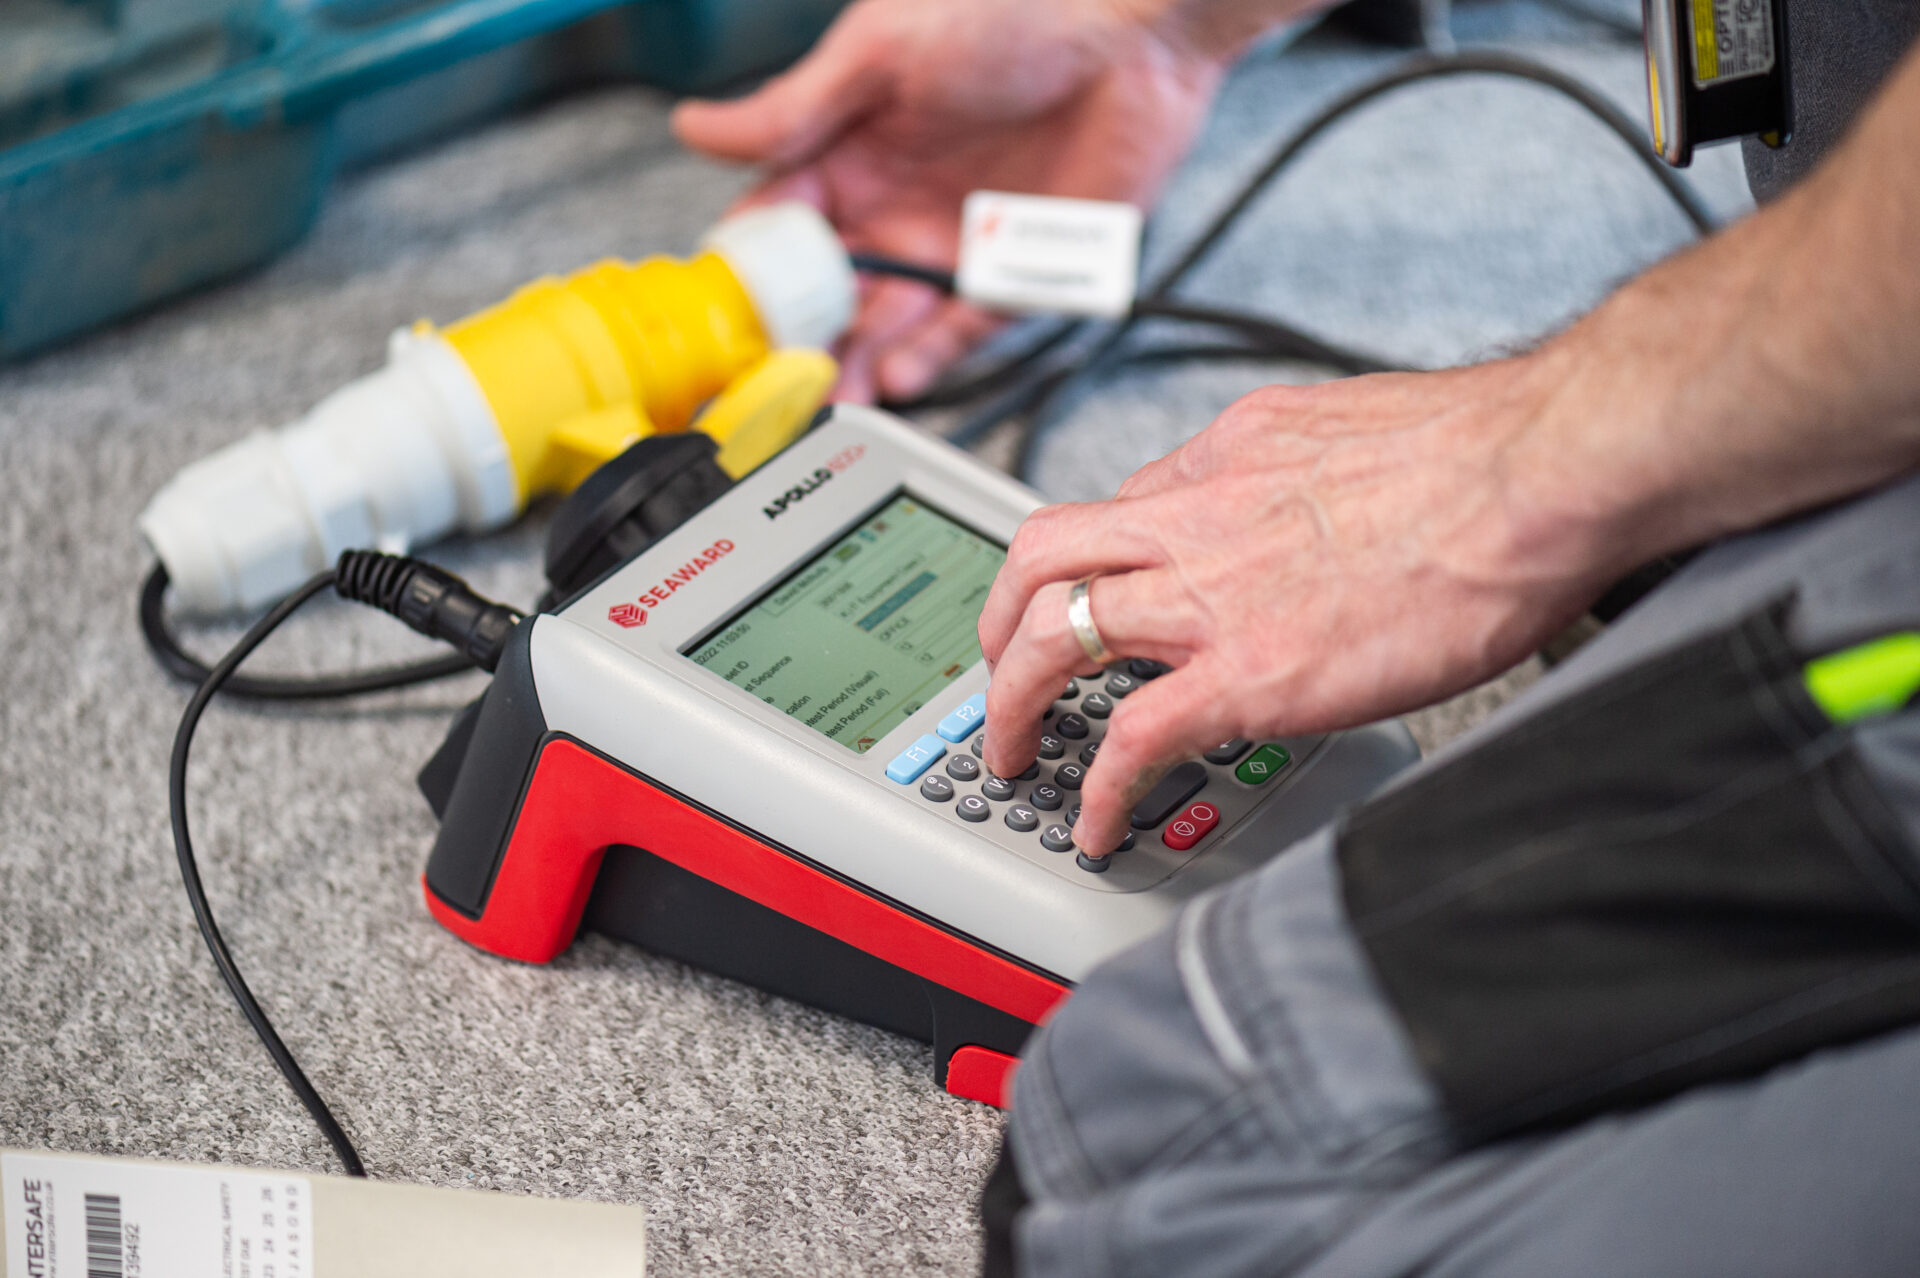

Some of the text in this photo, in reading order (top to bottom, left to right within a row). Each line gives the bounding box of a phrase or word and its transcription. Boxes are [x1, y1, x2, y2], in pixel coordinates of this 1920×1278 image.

[638, 538, 736, 608] SEAWARD
[751, 655, 793, 688] Sequence
[1113, 674, 1131, 687] U
[820, 692, 847, 714] Period
[845, 669, 880, 697] (Visual)
[1089, 694, 1105, 706] Y
[840, 703, 868, 726] Period
[865, 687, 890, 708] (Full)
[956, 704, 980, 721] F2
[1065, 715, 1081, 726] T
[1041, 736, 1058, 748] R
[905, 745, 929, 762] F1
[963, 761, 975, 770] 2
[1064, 766, 1080, 778] D
[989, 777, 1009, 789] W
[1039, 787, 1056, 798] S
[965, 797, 984, 809] Q
[1015, 808, 1032, 820] A
[1050, 826, 1068, 840] Z
